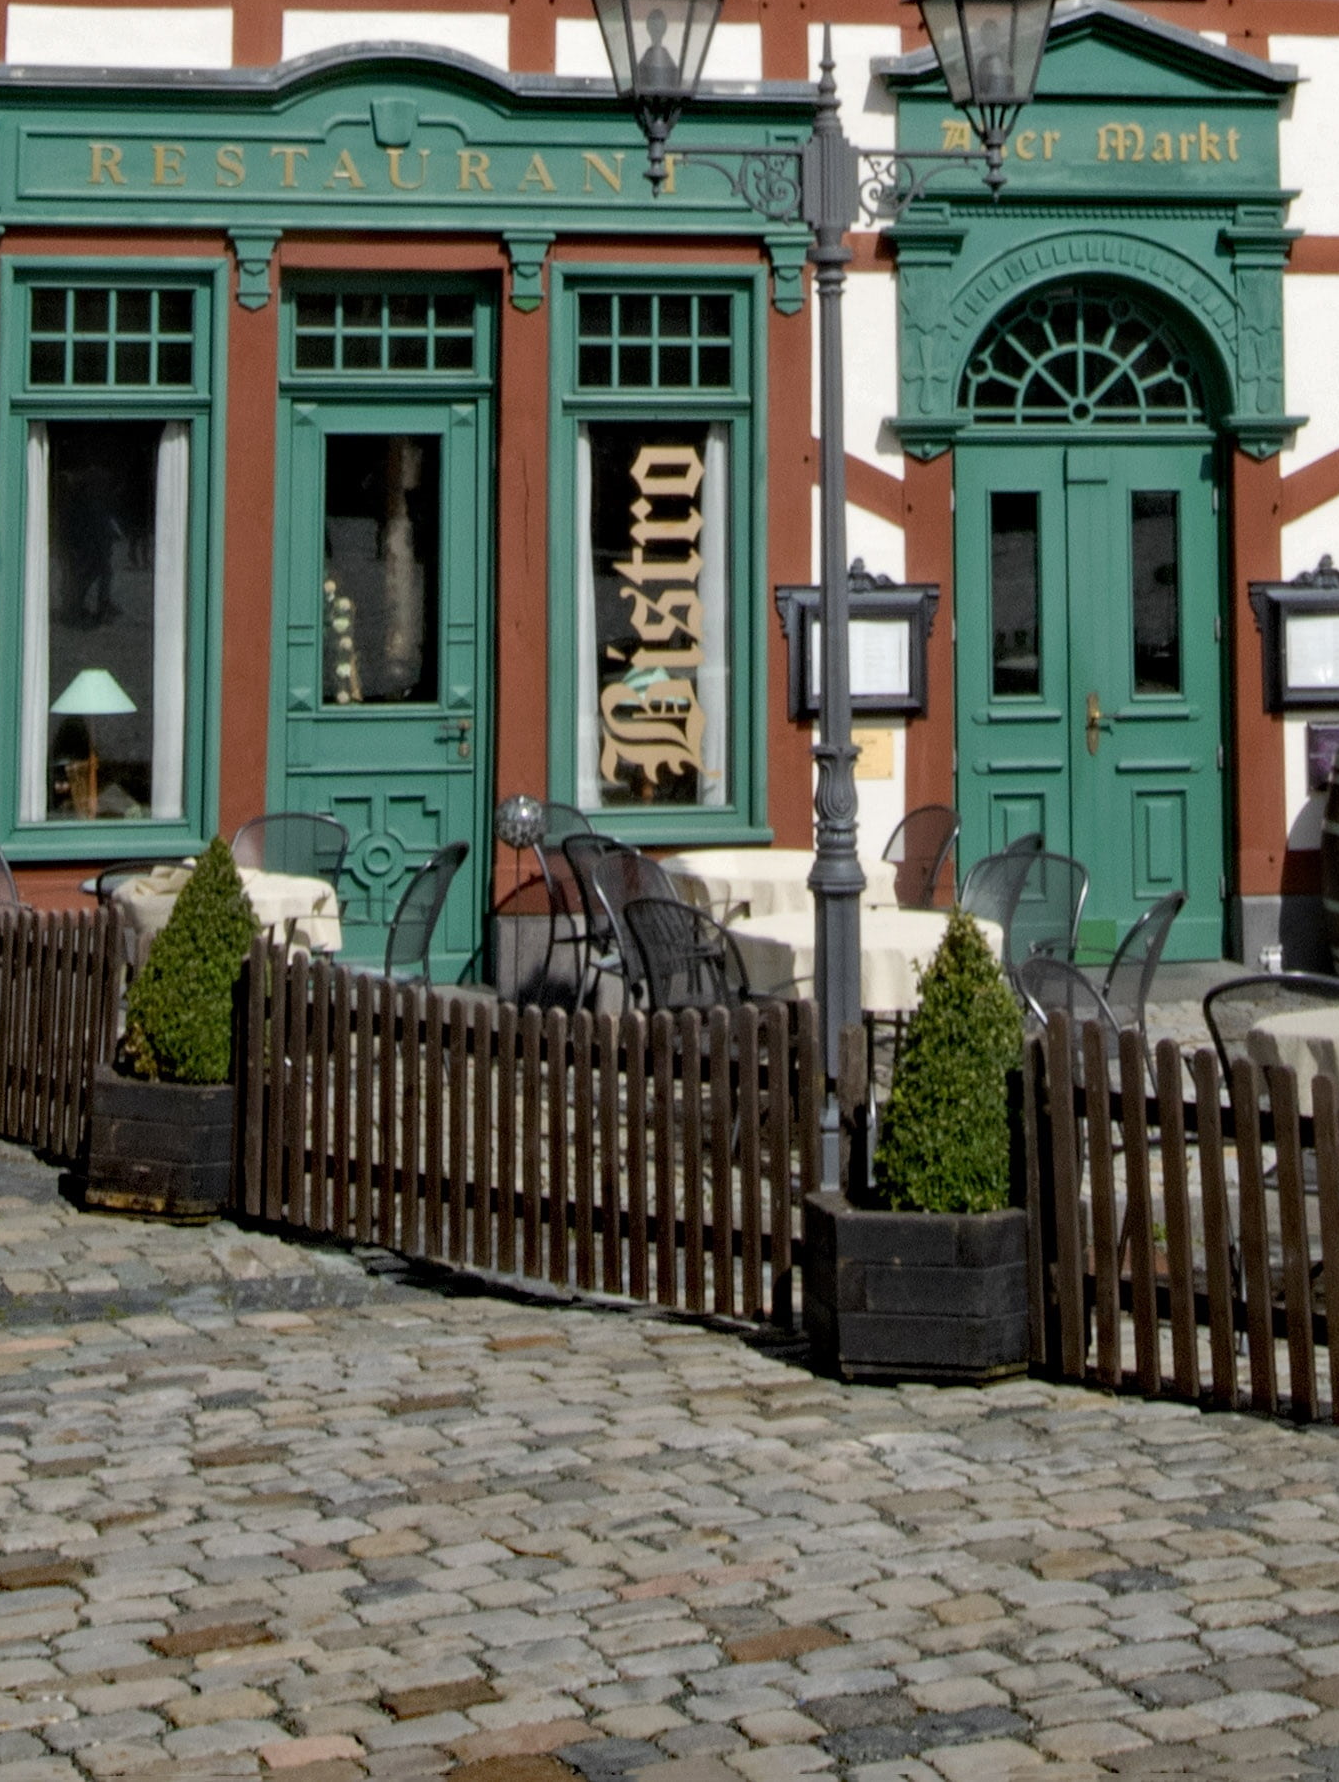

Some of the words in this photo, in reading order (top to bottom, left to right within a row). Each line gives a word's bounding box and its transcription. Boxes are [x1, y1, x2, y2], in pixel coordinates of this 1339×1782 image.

[941, 119, 1061, 161] Aer
[1096, 121, 1241, 163] Markt
[87, 143, 688, 194] RESTAURANT
[600, 446, 722, 785] Bistro
